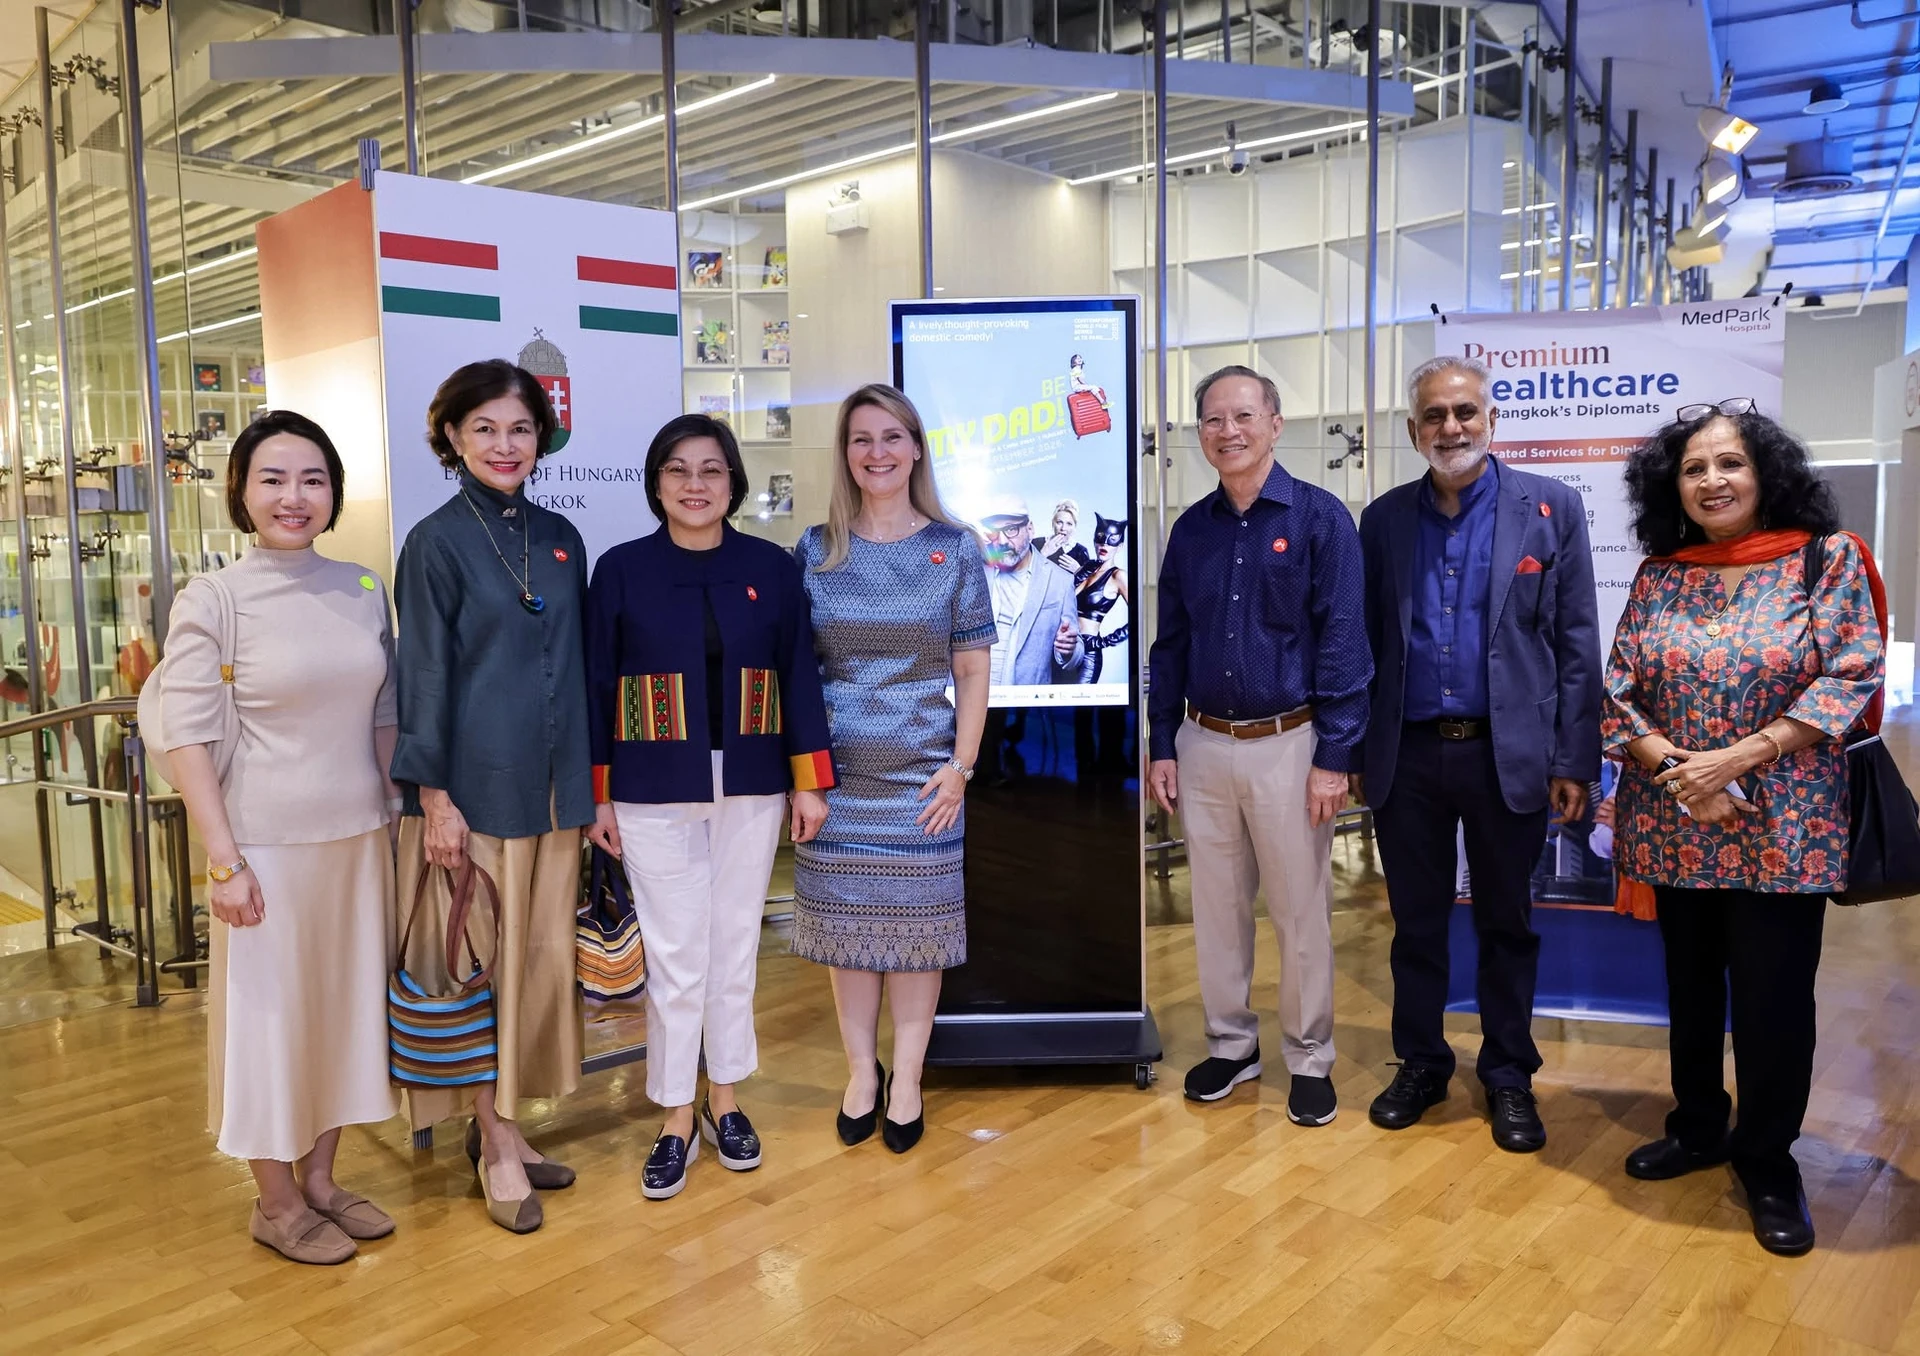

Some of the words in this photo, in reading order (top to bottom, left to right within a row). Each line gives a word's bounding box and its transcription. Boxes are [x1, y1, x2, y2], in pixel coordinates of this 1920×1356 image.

[1682, 307, 1771, 325] MedPark
[909, 320, 916, 329] A
[1725, 323, 1771, 332] Hospital
[909, 333, 951, 342] domestic
[954, 332, 994, 342] comedy!
[1463, 341, 1610, 369] Premium
[1041, 376, 1066, 398] BE
[1492, 370, 1680, 401] ealthcare
[1577, 402, 1660, 418] Diplomats
[926, 420, 977, 458] MY
[983, 397, 1066, 445] DAD!
[1489, 448, 1527, 459] cated
[1530, 446, 1584, 458] Services
[1587, 445, 1606, 456] for
[1550, 474, 1581, 482] ccess
[532, 494, 587, 509] GKOK
[1597, 579, 1632, 589] eckup
